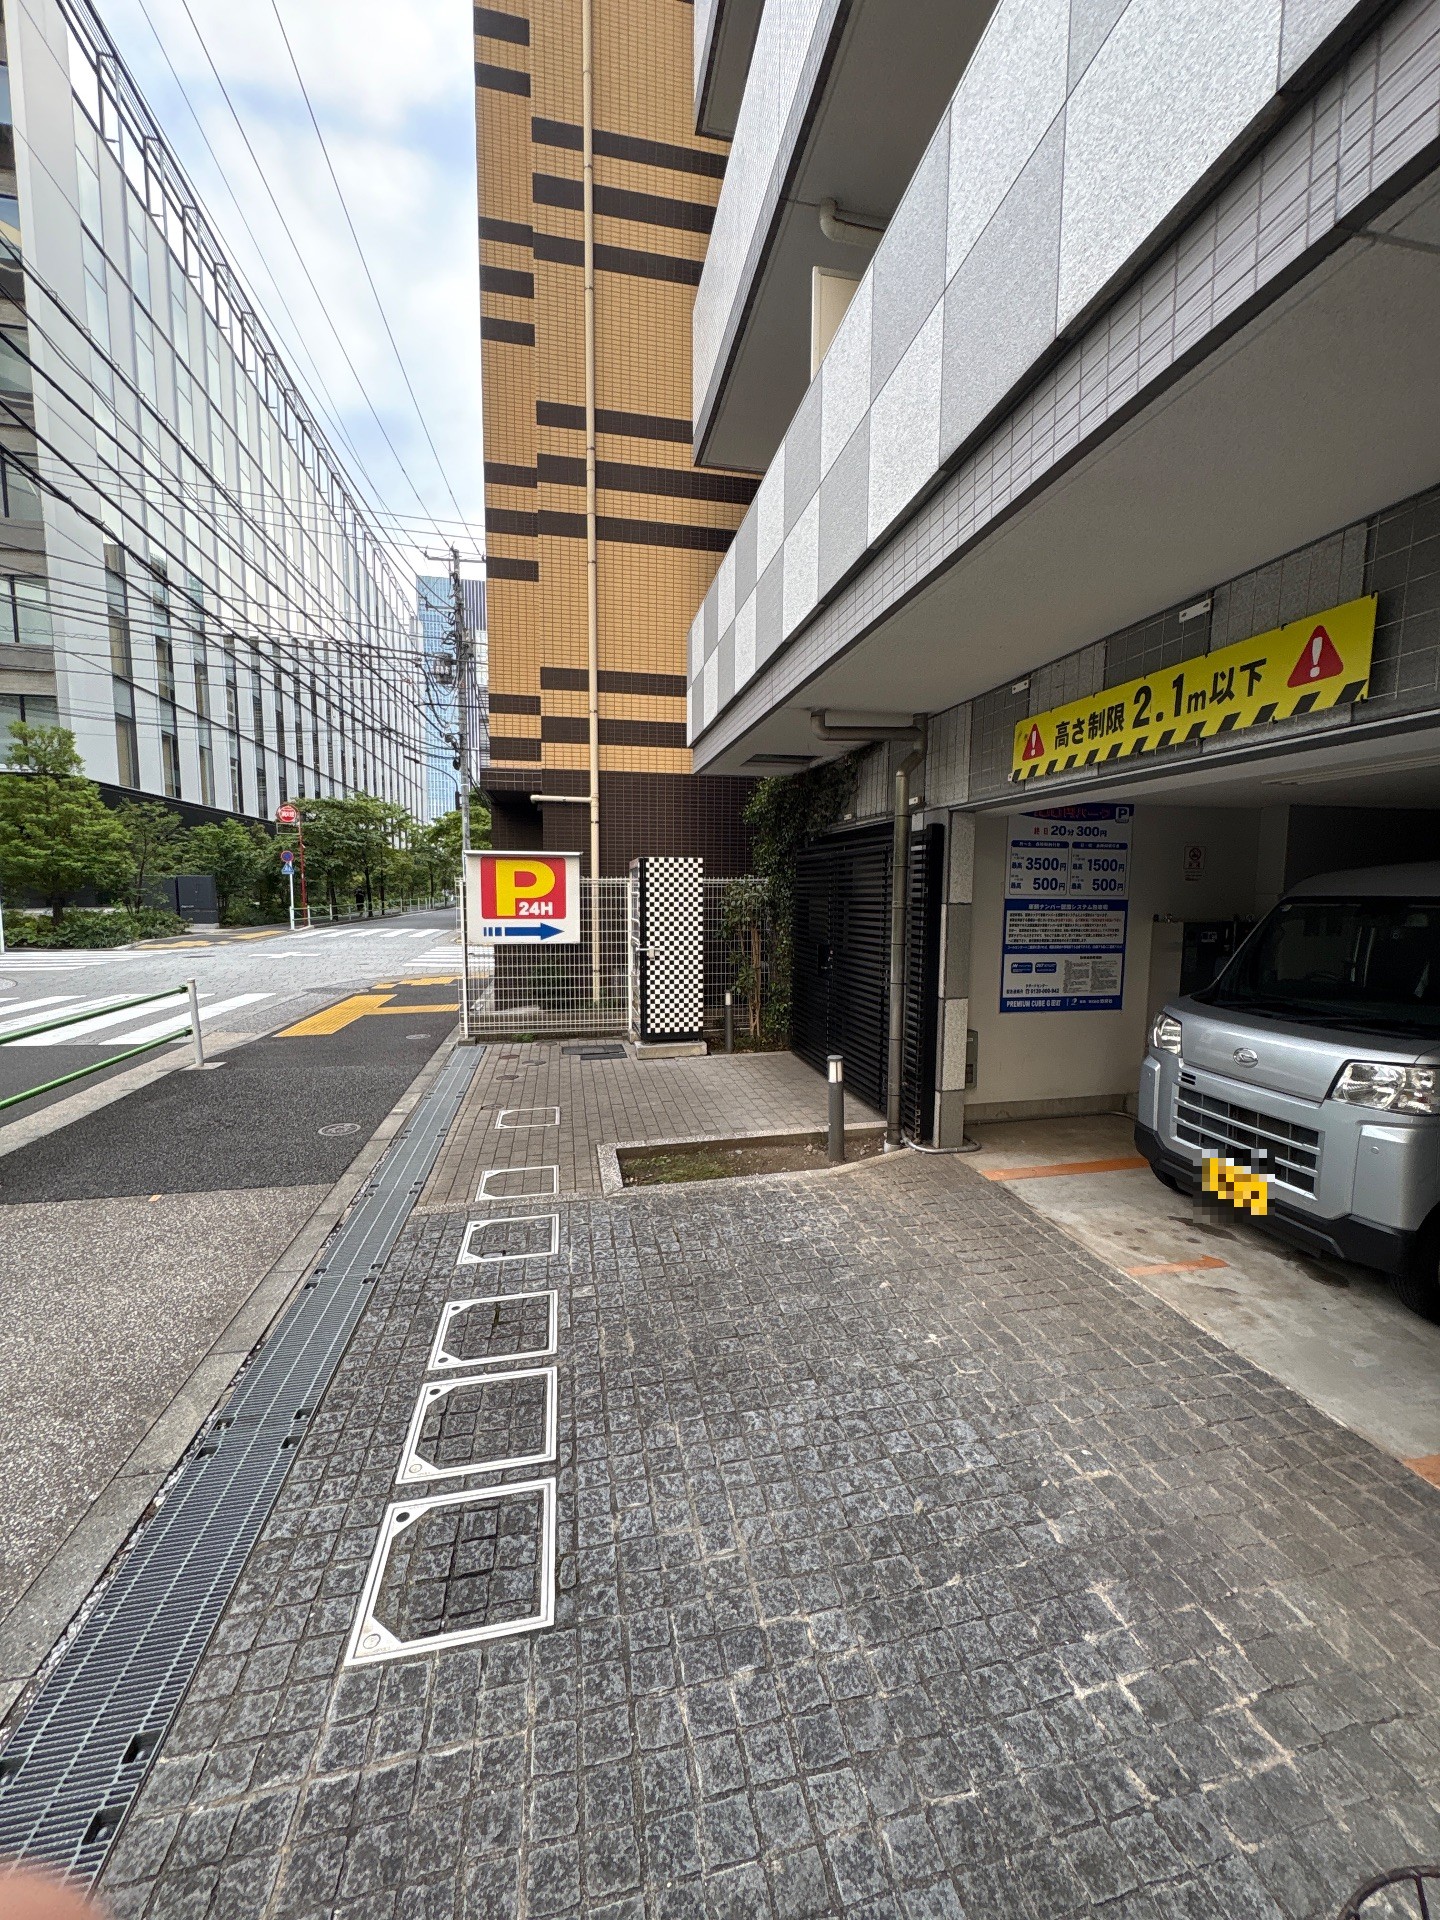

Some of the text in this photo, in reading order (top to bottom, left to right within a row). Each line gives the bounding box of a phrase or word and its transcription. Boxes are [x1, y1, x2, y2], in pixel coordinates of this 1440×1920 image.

[1054, 657, 1267, 750] 高さ制限 2.1m以下
[1118, 807, 1128, 819] P
[1051, 825, 1075, 836] 20分
[1076, 825, 1108, 837] 300円
[1025, 857, 1067, 872] 3500円
[1087, 858, 1125, 872] 1500円
[495, 859, 556, 917] P
[1032, 877, 1066, 891] 500円
[1092, 878, 1124, 892] 500円
[518, 901, 554, 916] 24H
[1006, 1000, 1031, 1008] PREMIUM
